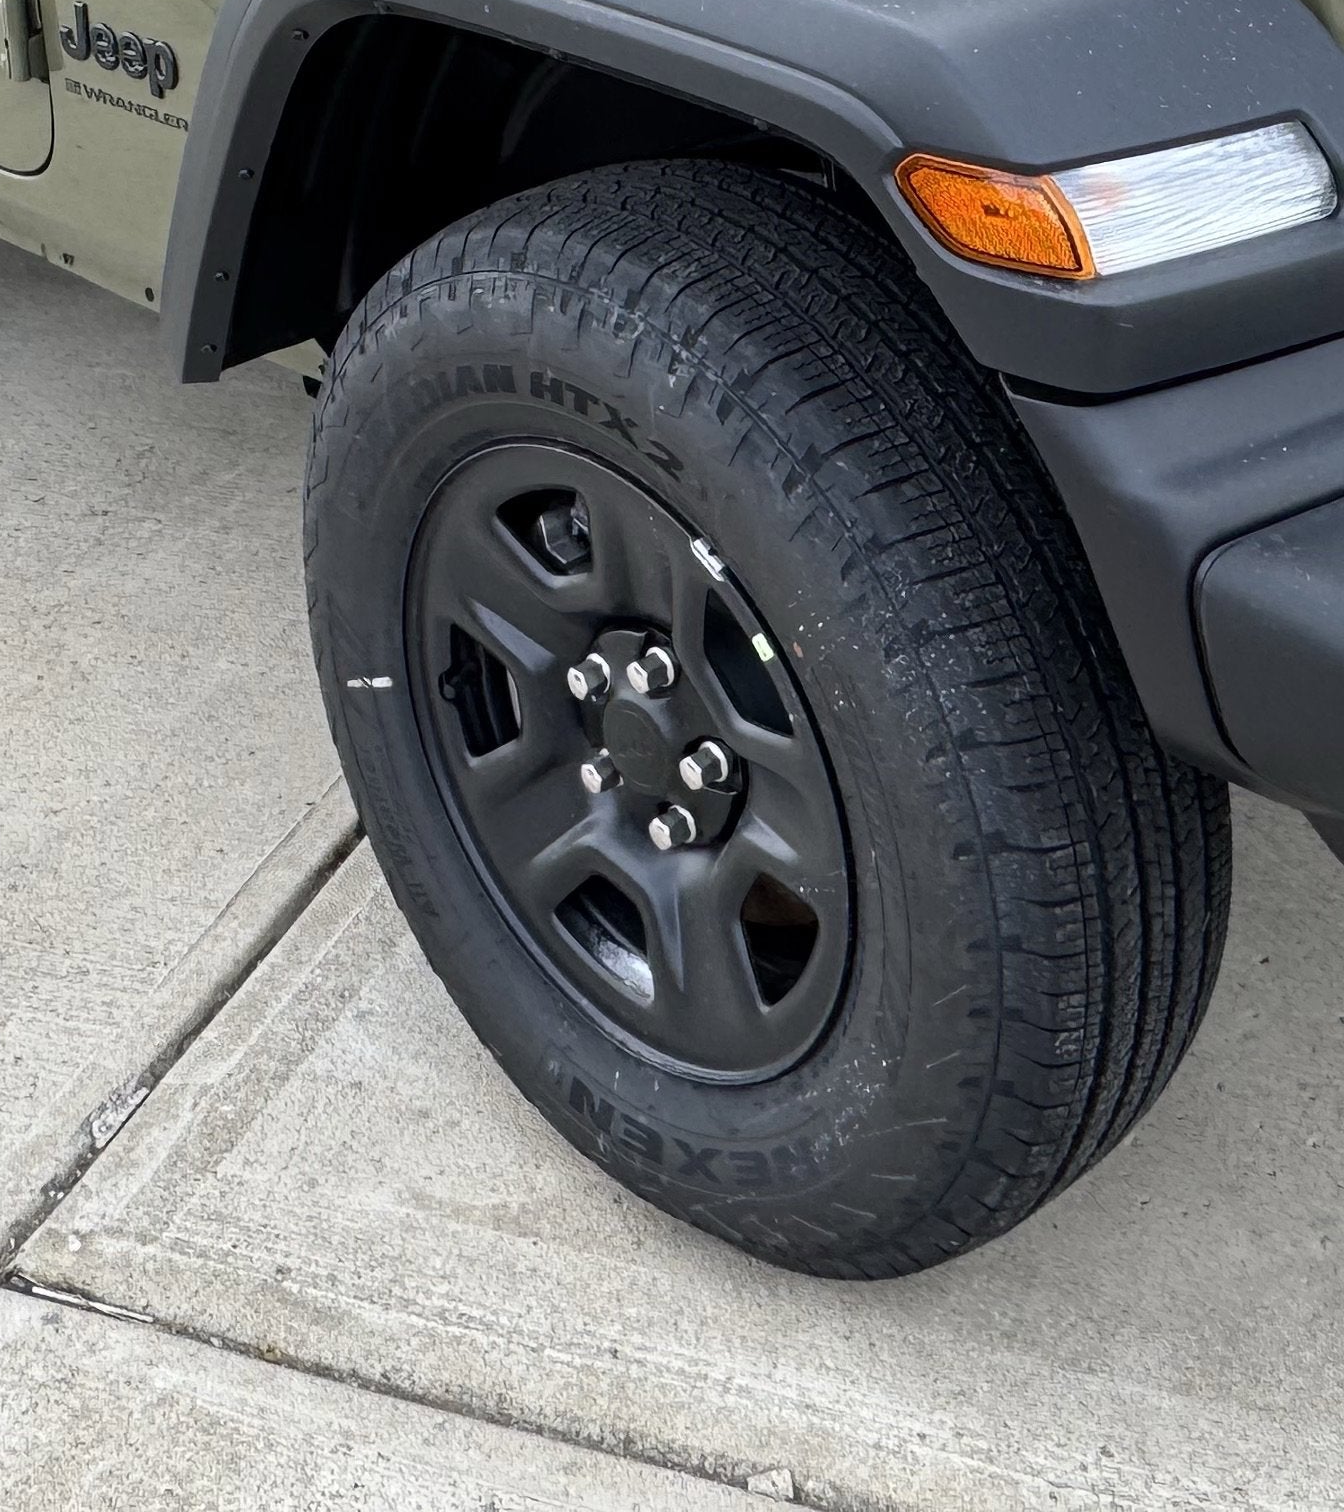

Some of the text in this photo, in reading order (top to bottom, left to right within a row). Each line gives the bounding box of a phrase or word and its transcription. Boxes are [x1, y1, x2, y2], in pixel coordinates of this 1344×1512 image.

[59, 0, 179, 99] Jeep
[81, 83, 189, 132] WRANGLER
[529, 371, 640, 450] HTX
[567, 1074, 822, 1188] NEXEN
